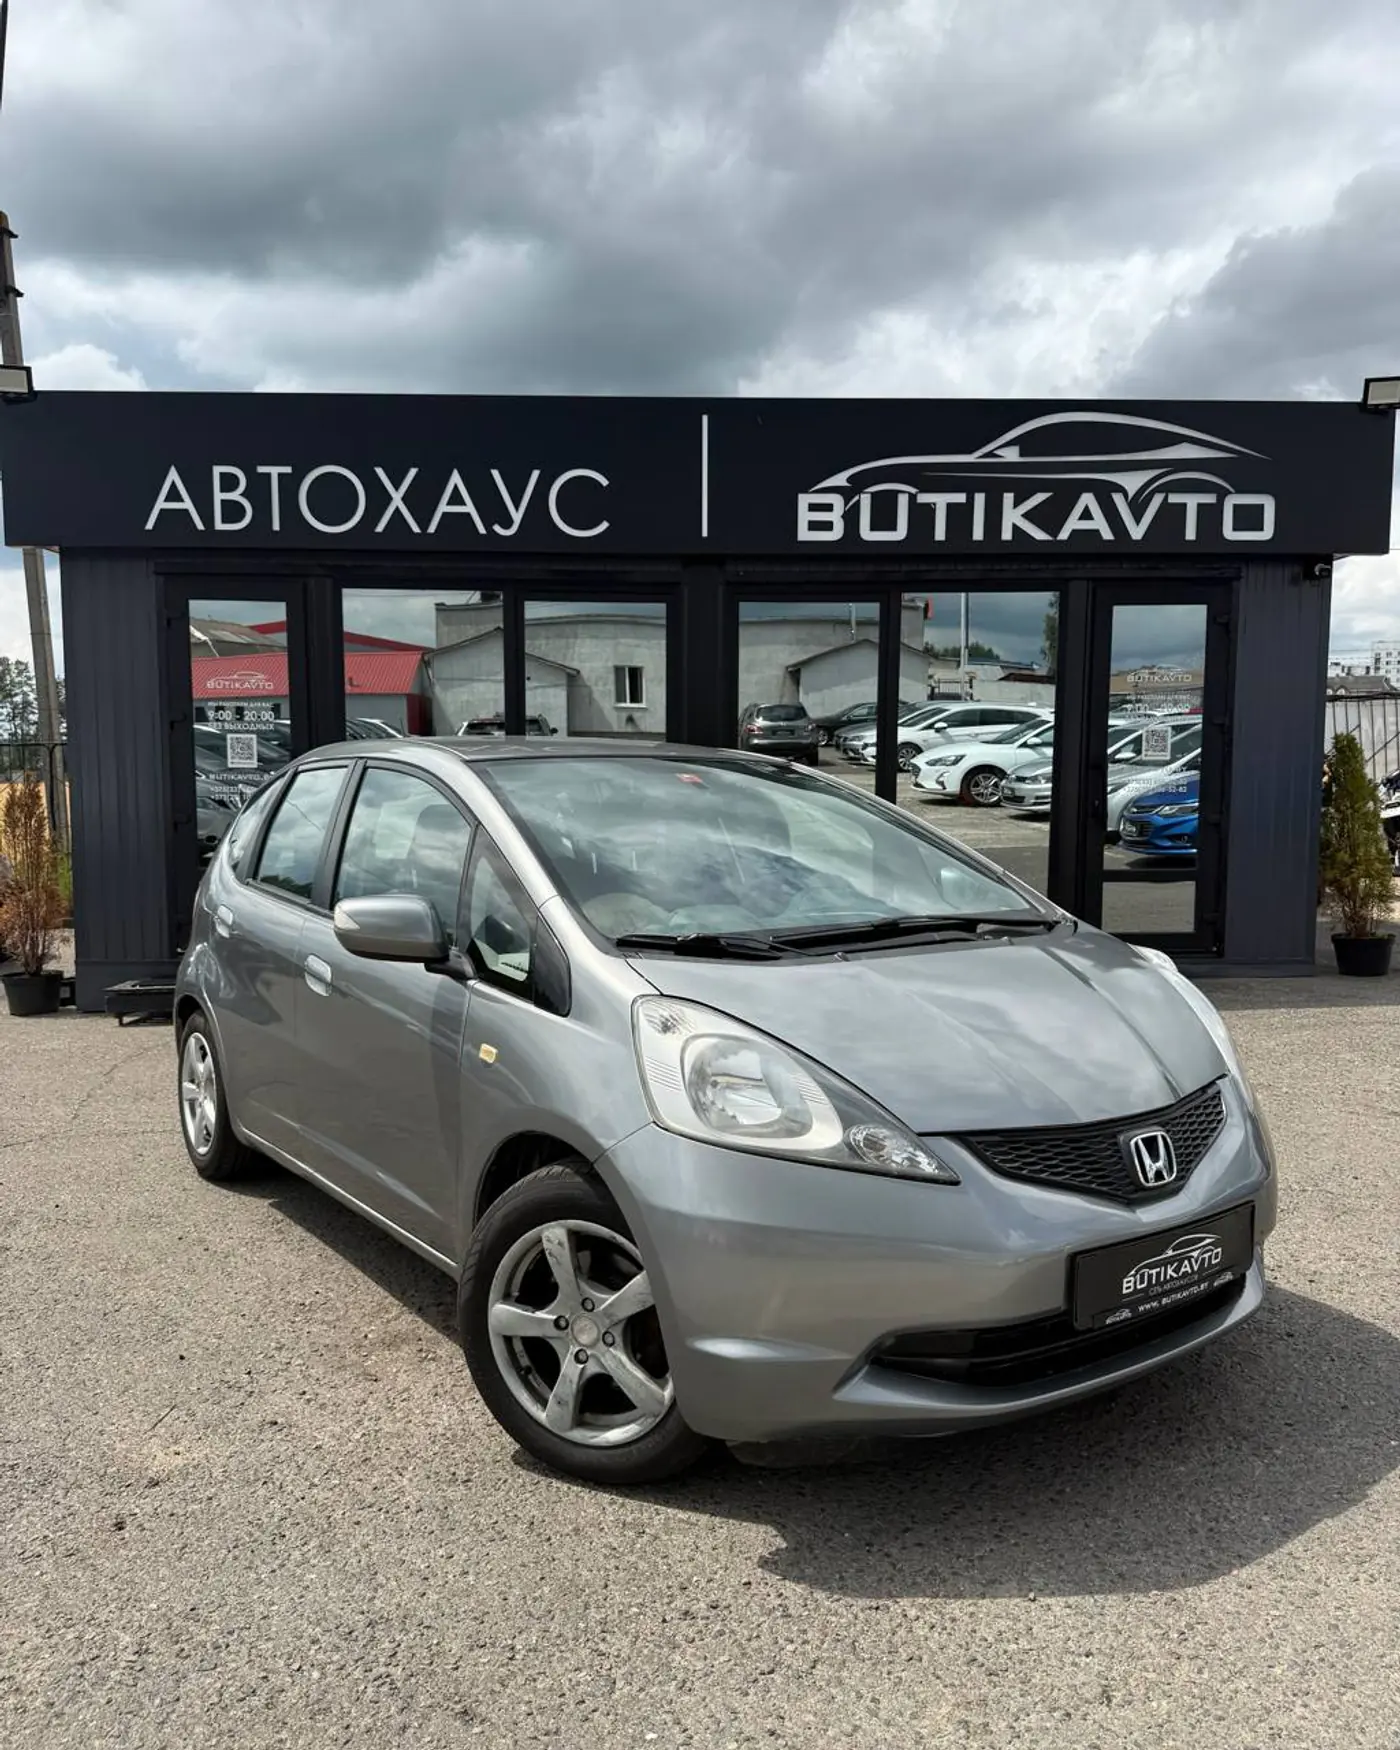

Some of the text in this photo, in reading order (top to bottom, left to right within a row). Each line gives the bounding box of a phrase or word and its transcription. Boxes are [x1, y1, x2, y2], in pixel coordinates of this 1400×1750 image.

[144, 464, 610, 537] АВТОХАУС
[797, 492, 1276, 542] BUTIKAVTO
[207, 681, 274, 689] BUTIKAVTO
[1127, 674, 1192, 683] BUTIKAVTO
[208, 711, 232, 720] 9:00
[1122, 1247, 1222, 1295] BUTIKAVTO
